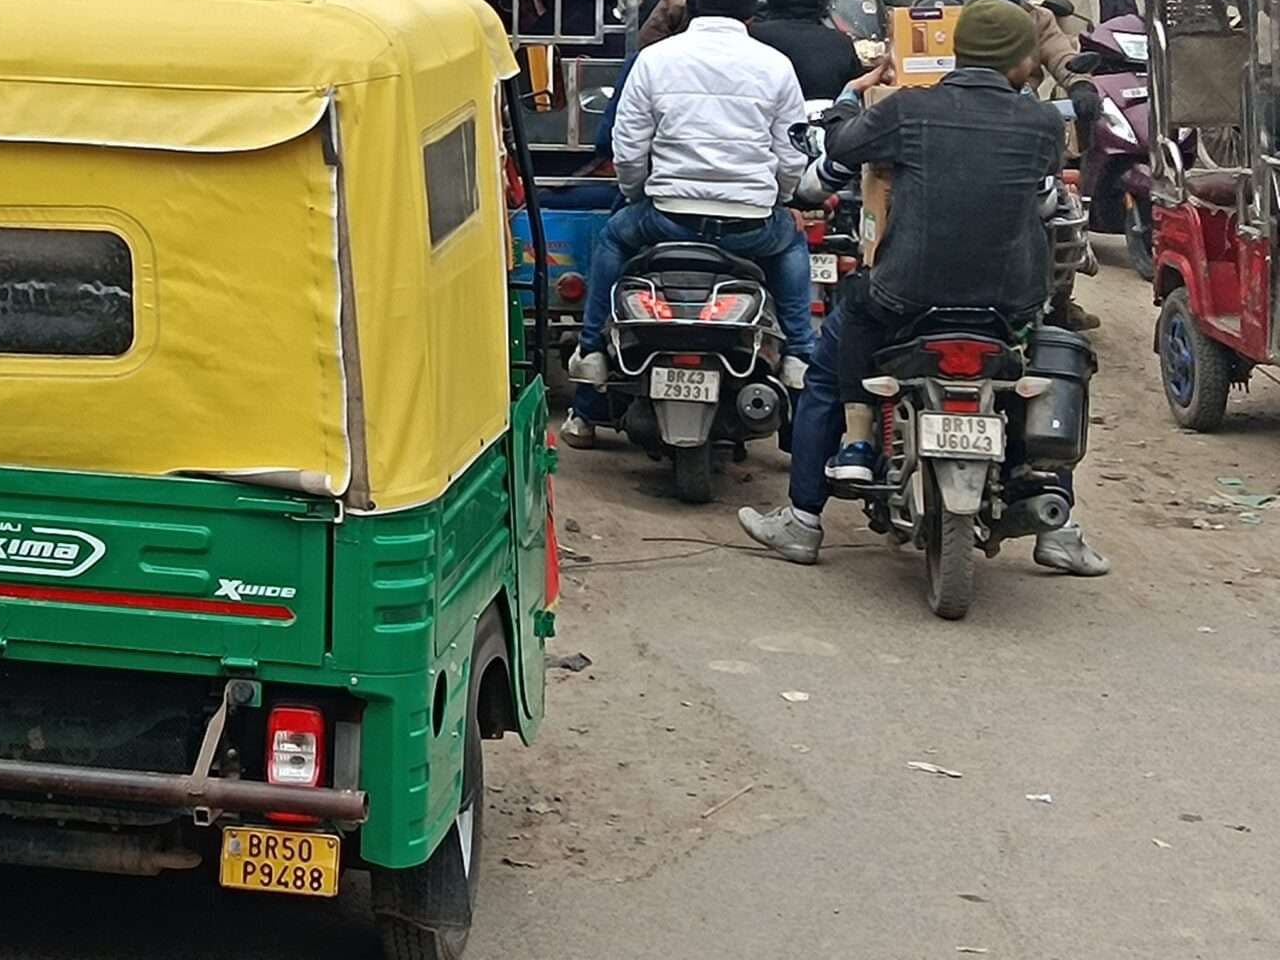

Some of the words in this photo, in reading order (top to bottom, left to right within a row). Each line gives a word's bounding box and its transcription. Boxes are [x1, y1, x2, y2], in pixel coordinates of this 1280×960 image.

[663, 383, 709, 400] Z9331
[942, 417, 986, 434] BR19
[936, 433, 993, 452] U6043
[248, 833, 312, 862] BR50
[242, 860, 323, 892] P9488
